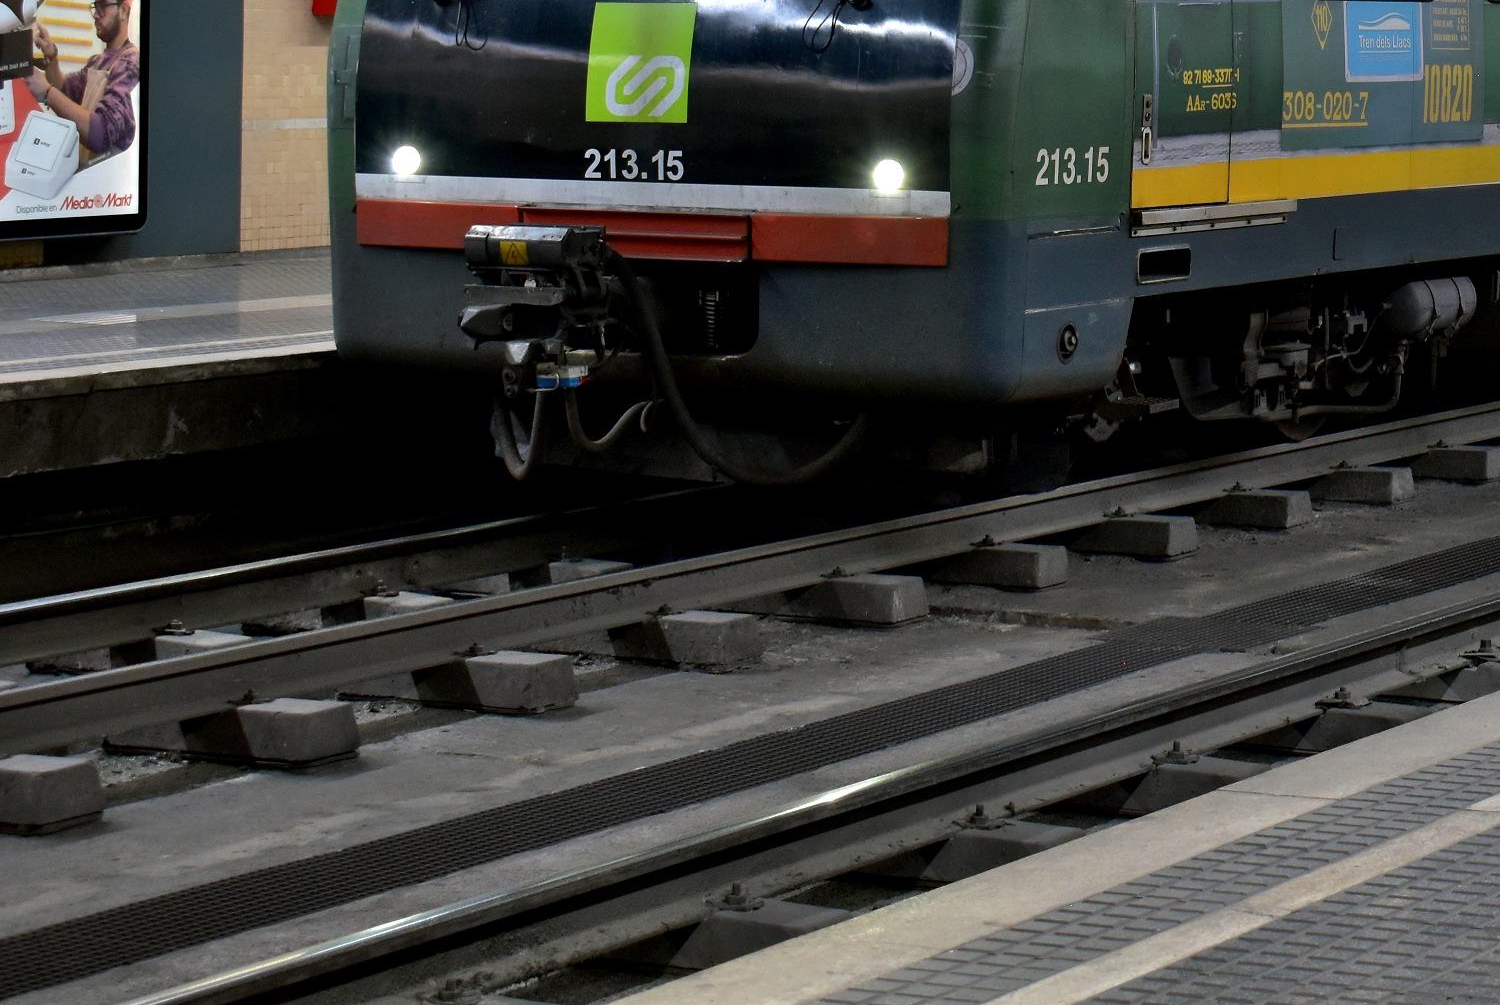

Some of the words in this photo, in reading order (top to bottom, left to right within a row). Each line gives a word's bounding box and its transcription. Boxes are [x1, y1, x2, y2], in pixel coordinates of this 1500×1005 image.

[1359, 35, 1375, 49] Tren
[1376, 35, 1391, 49] dels
[1392, 35, 1411, 49] Llacs
[1283, 90, 1368, 121] 308-020-7
[1424, 64, 1473, 124] 10820
[584, 148, 684, 181] 213.15
[1035, 146, 1110, 186] 213.15
[16, 205, 48, 215] Disponible
[49, 204, 57, 213] en
